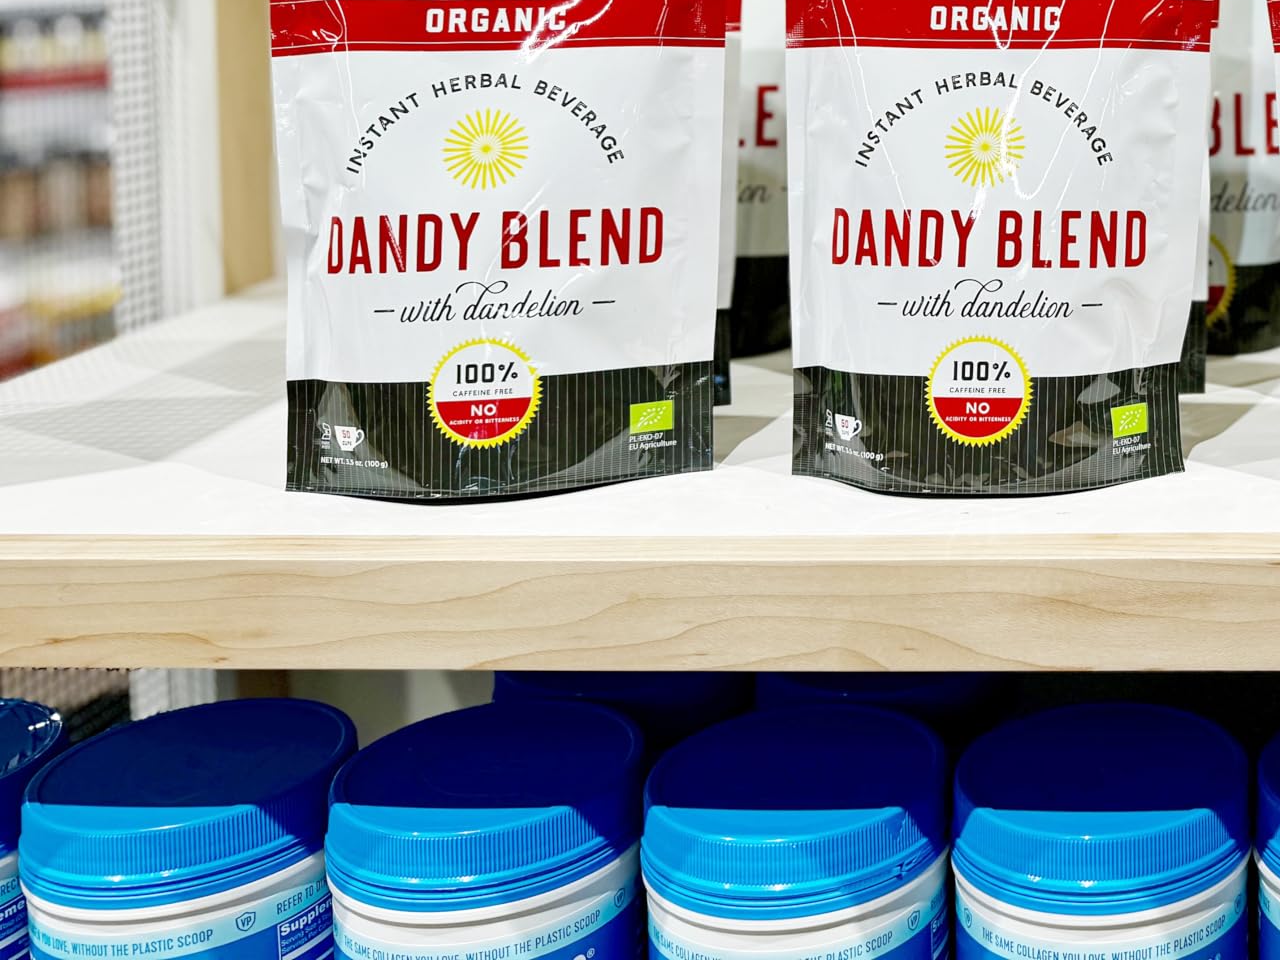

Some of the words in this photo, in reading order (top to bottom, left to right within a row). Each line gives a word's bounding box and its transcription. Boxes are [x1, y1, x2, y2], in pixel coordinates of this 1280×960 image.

[425, 7, 567, 33] ORGANIC
[930, 6, 1060, 31] ORGANIC
[346, 92, 420, 175] INSTANT
[432, 73, 522, 98] HERBAL
[535, 80, 625, 165] BEVERAGE
[855, 89, 925, 168] INSTANT
[935, 71, 1018, 96] HERBAL
[1031, 80, 1113, 166] BEVERAGE
[327, 212, 480, 275] DANDY
[501, 206, 663, 269] BLEND
[832, 207, 974, 268] DANDY
[997, 209, 1147, 268] BLEND
[400, 291, 455, 324] with
[456, 281, 584, 321] dandelion
[902, 290, 954, 318] with
[954, 278, 1074, 319] dandelion
[457, 362, 518, 384] 100%
[953, 361, 1010, 381] 100%
[471, 404, 496, 416] NO
[966, 402, 990, 414] NO
[640, 440, 677, 450] Agriculture
[277, 892, 302, 915] REFER
[306, 885, 313, 899] TO
[241, 915, 251, 927] VP
[344, 935, 353, 950] THE
[355, 943, 371, 959] SAME
[514, 940, 531, 955] THE
[536, 925, 571, 949] PLASTIC
[574, 910, 600, 933] SCOOP
[983, 927, 992, 943] THE
[995, 935, 1013, 952] SAME
[1156, 942, 1170, 955] THE
[1174, 929, 1203, 952] PLASTIC
[1206, 915, 1225, 937] SCOOP
[52, 938, 70, 954] LOVE,
[71, 943, 107, 957] WITHOUT
[113, 944, 129, 956] THE
[132, 939, 173, 956] PLASTIC
[178, 929, 213, 948] SCOOP
[866, 931, 893, 952] SCOOP
